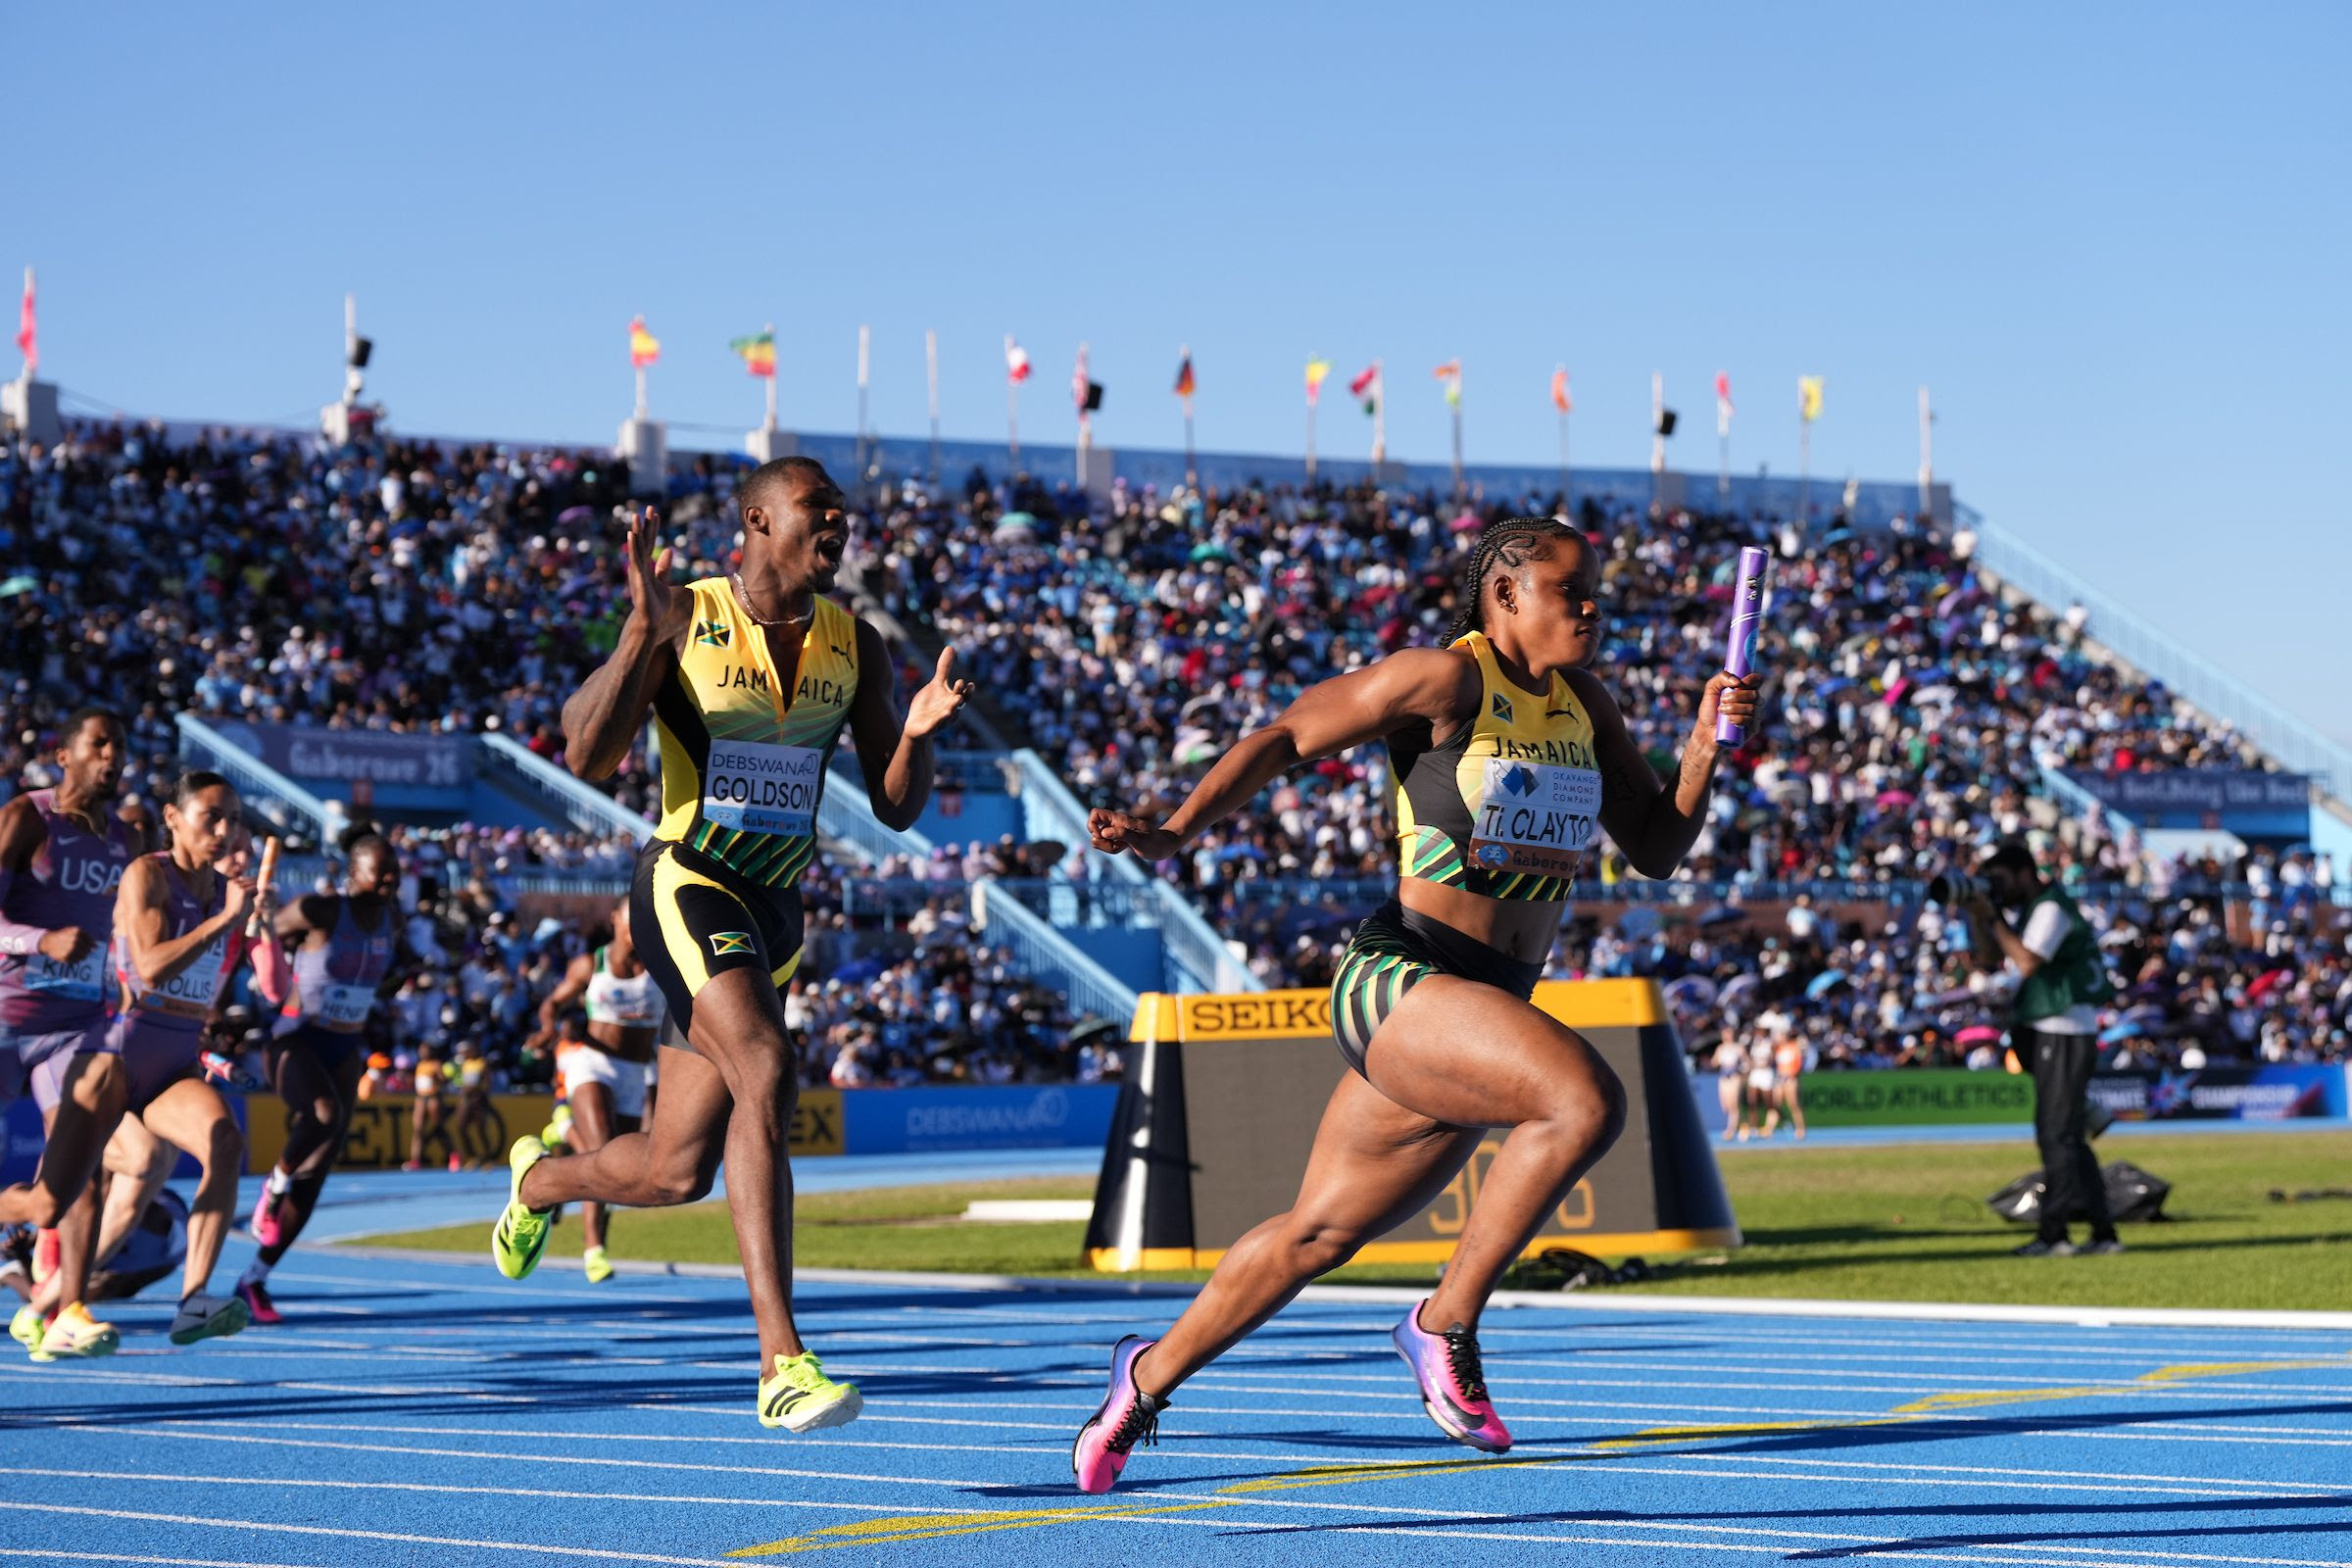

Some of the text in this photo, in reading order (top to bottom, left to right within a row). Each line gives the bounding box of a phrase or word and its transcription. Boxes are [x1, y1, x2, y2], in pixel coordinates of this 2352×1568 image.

[289, 741, 419, 780] Gaborone
[711, 754, 806, 777] DEBSWANA
[1490, 736, 1592, 770] JAMAICA
[712, 775, 814, 810] GOLDSON
[1552, 793, 1594, 806] COMPANY
[61, 857, 122, 894] USA
[43, 956, 93, 982] KING
[159, 975, 213, 1001] OLLIS
[1887, 1083, 2030, 1109] ATHLETICS
[906, 1104, 1047, 1137] DEBSWANA
